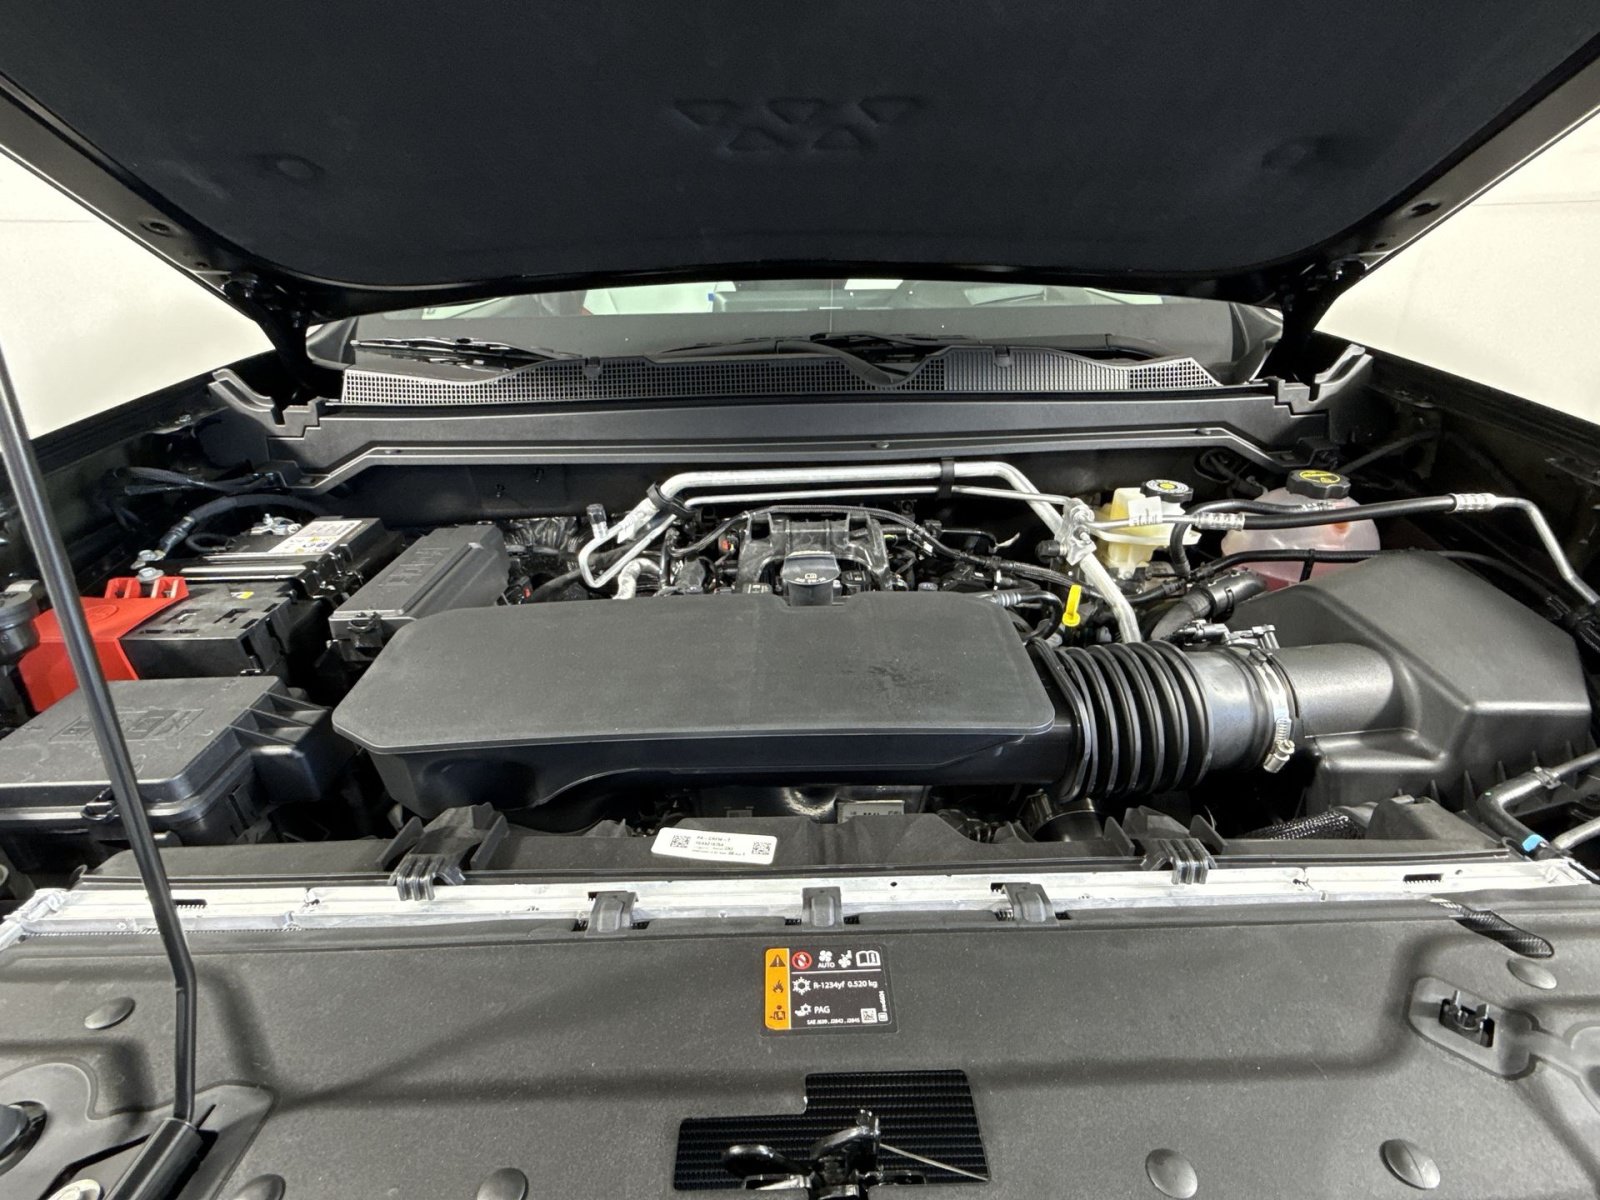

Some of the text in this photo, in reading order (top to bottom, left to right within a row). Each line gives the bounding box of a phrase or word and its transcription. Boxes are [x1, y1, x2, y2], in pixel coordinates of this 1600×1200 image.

[813, 980, 845, 990] R-1234yf
[868, 980, 878, 988] kg
[814, 1006, 830, 1014] PAG
